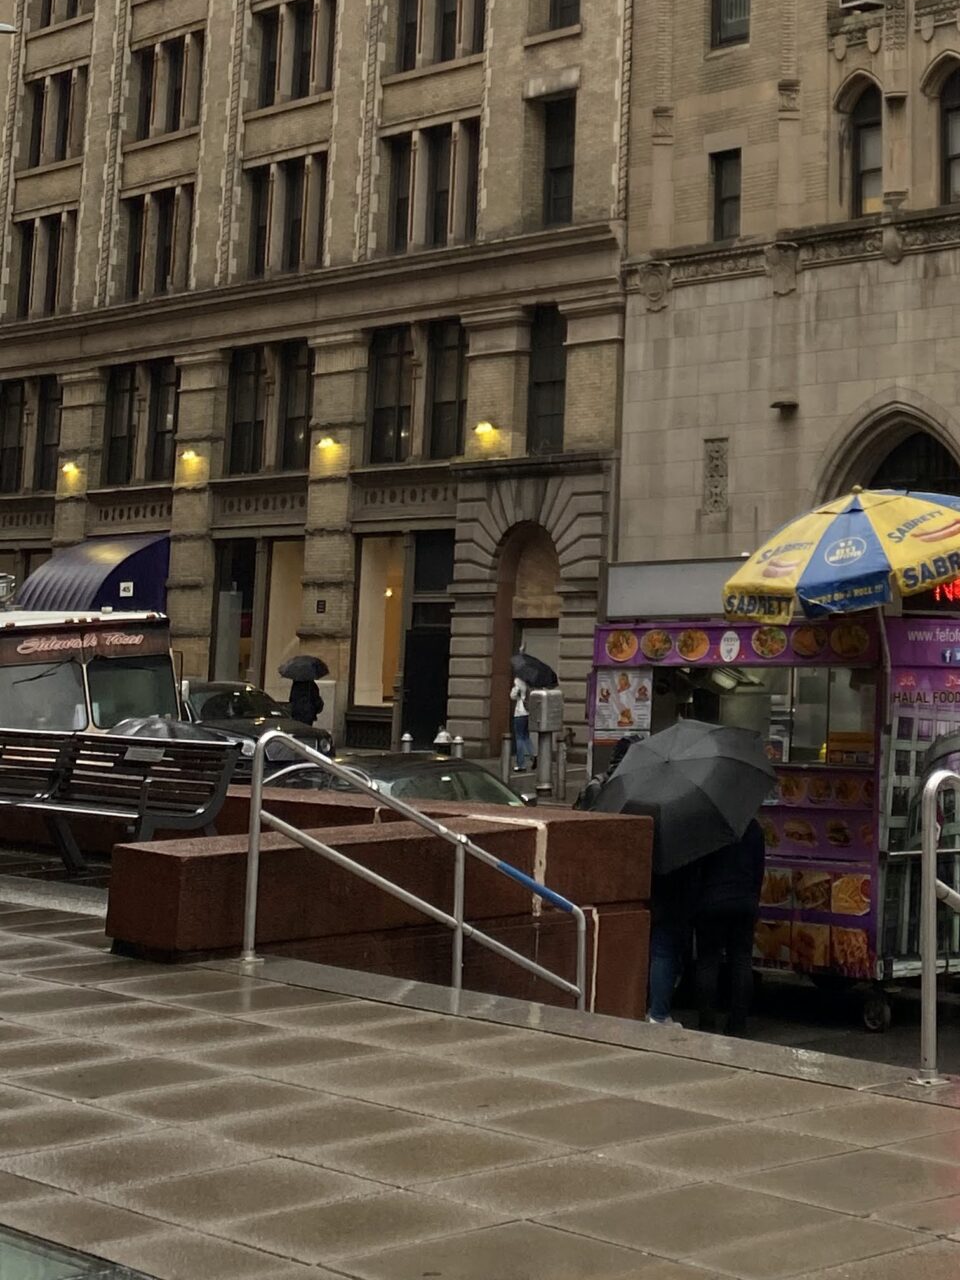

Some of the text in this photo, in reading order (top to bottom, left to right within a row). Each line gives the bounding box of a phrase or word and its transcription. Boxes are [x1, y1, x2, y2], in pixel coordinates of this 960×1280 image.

[886, 509, 944, 544] SABRETT
[723, 593, 795, 616] SABRETT
[893, 691, 930, 704] HALAL
